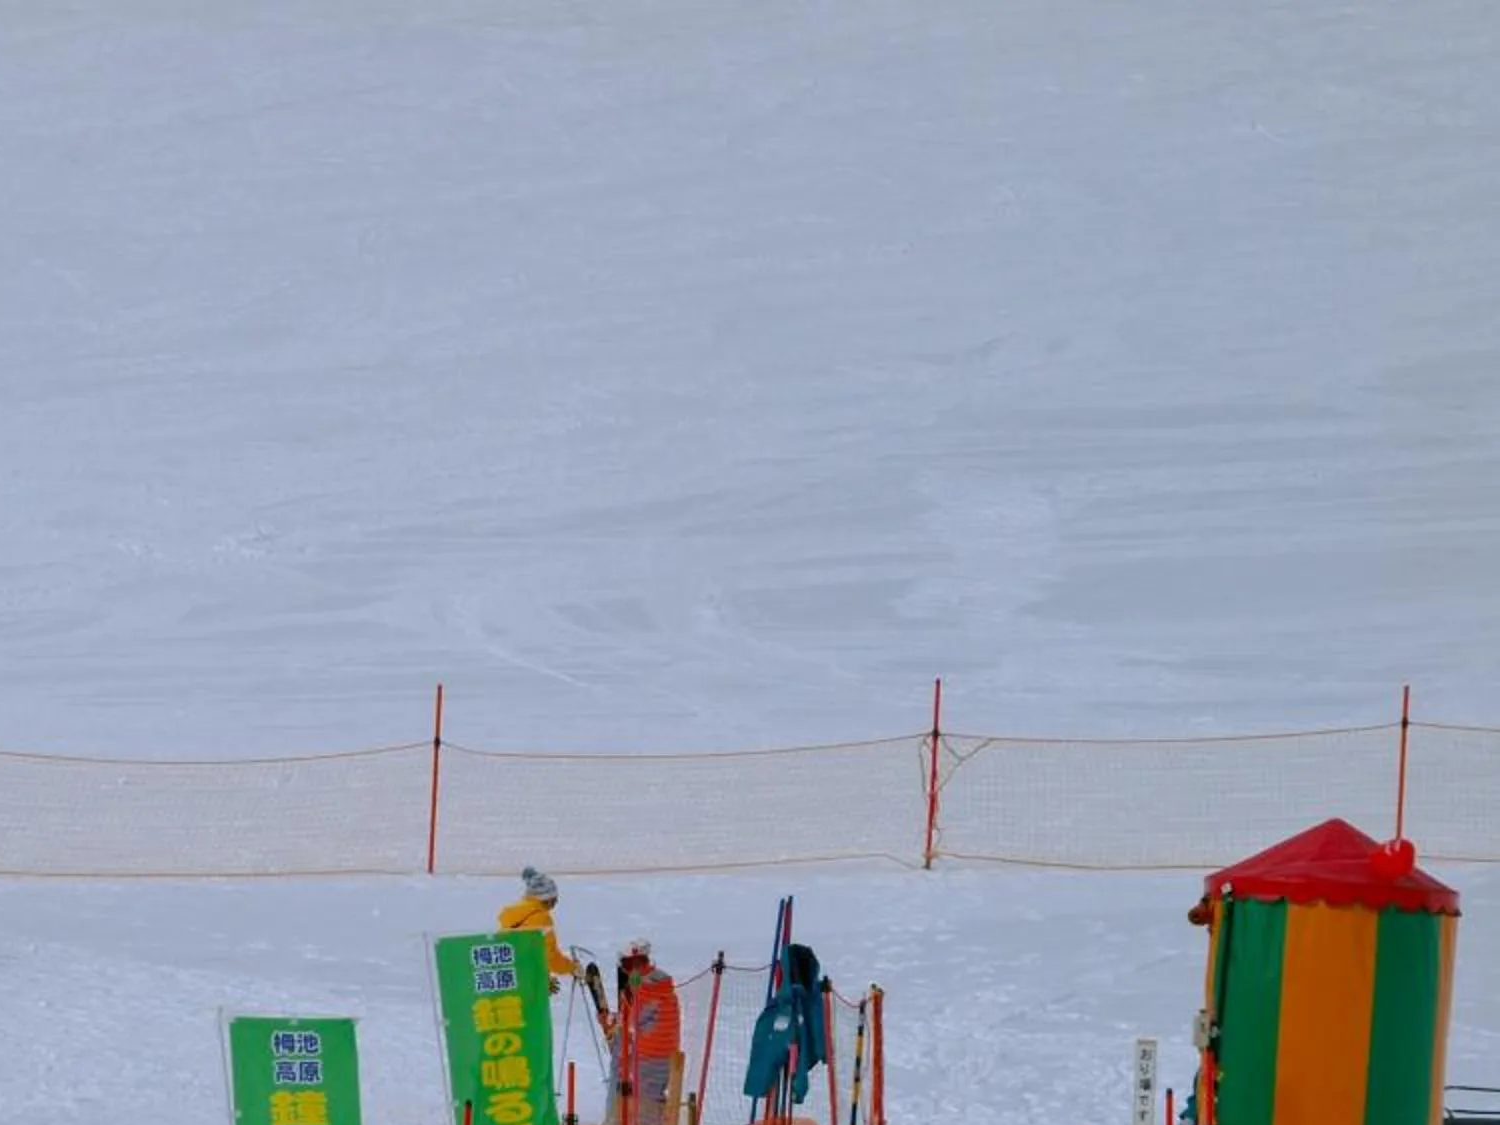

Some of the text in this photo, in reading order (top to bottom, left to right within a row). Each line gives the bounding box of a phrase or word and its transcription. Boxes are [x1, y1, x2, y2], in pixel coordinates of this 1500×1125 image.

[474, 969, 516, 993] 高原
[271, 1030, 320, 1057] 栂池
[274, 1059, 323, 1084] 高原
